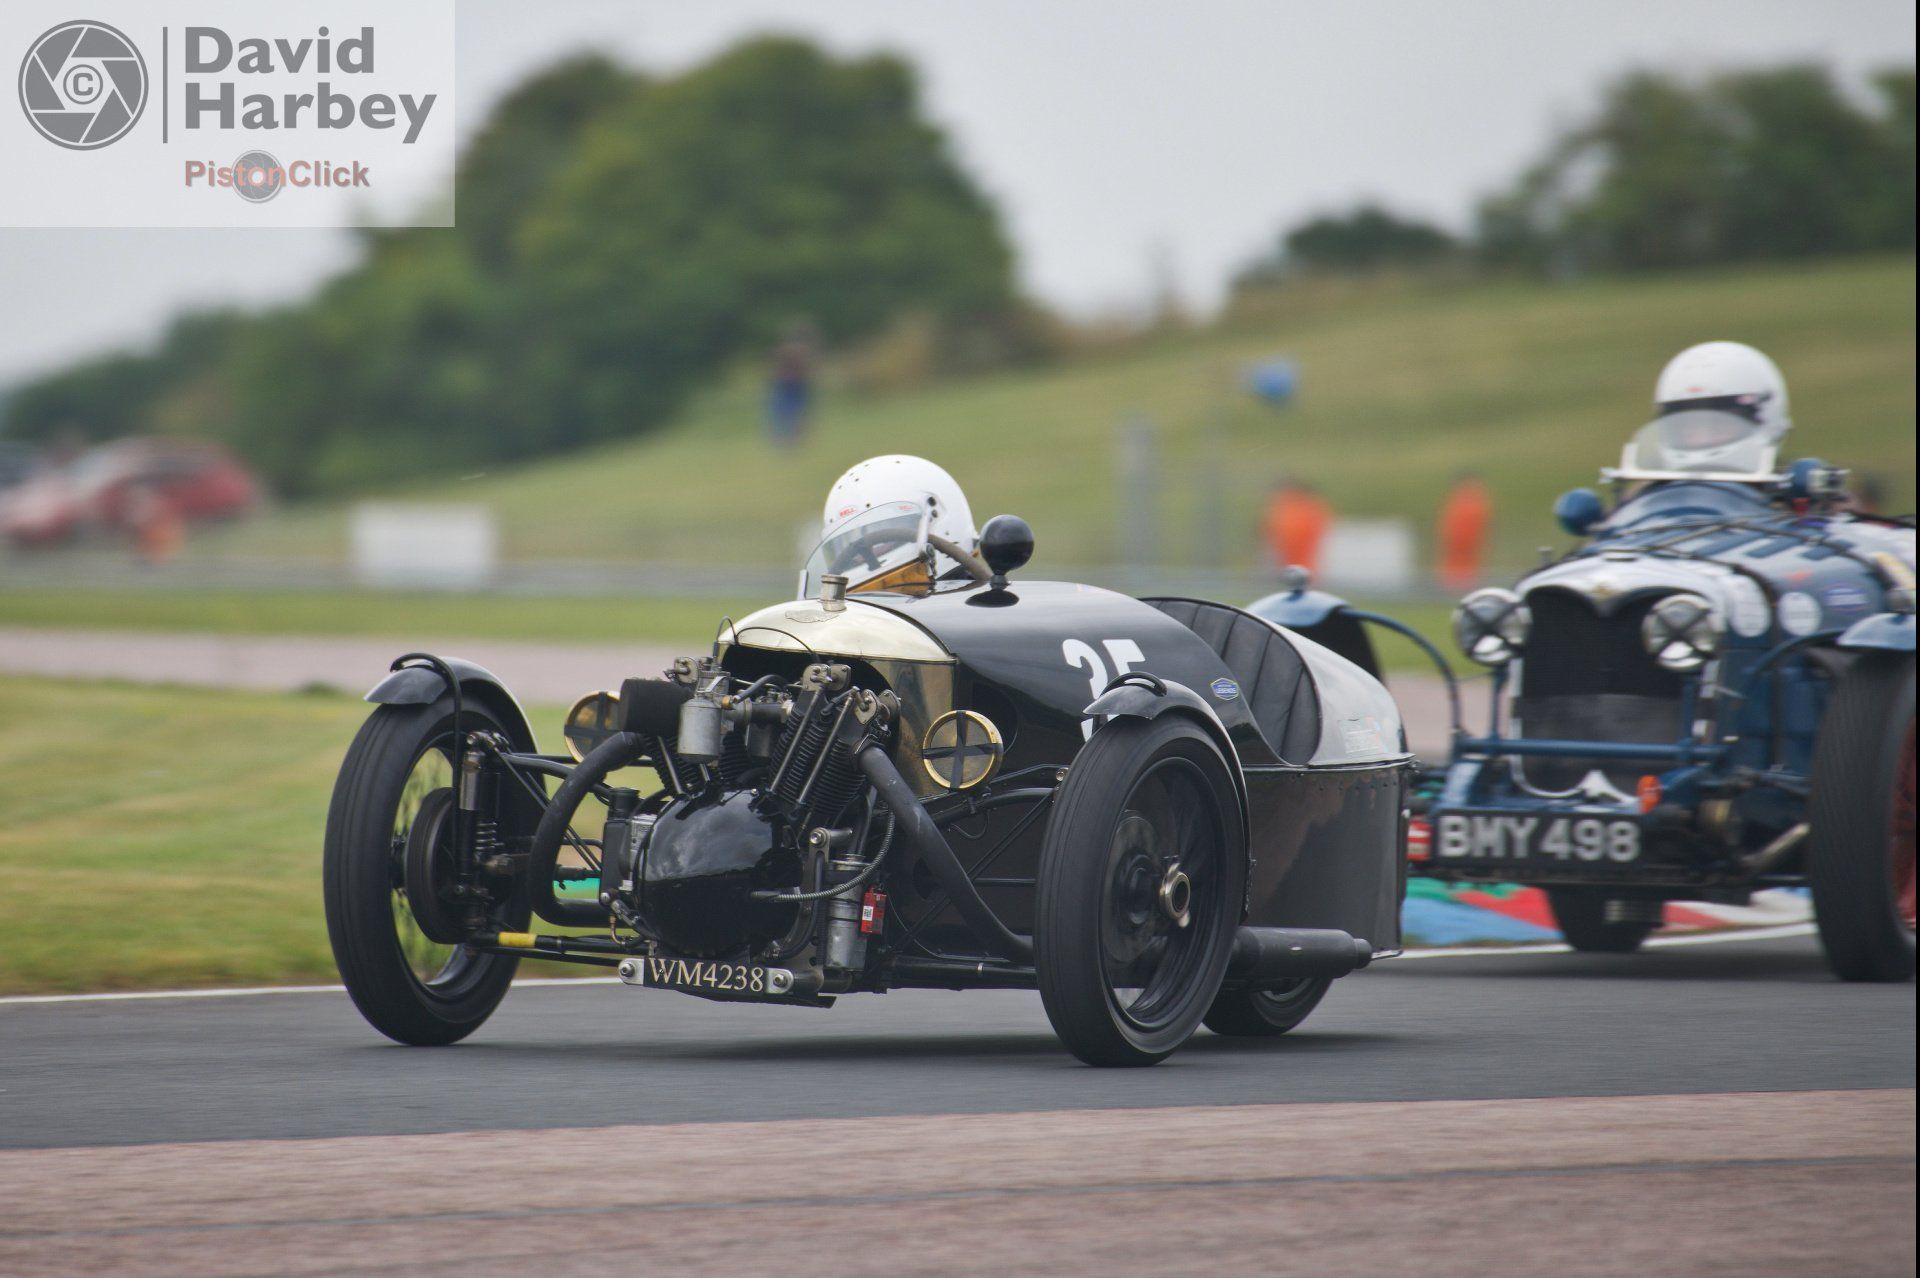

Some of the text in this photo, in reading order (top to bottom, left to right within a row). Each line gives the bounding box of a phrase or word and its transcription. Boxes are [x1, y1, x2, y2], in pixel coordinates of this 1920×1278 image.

[1437, 815, 1641, 862] BMY 498
[648, 957, 764, 992] WM4238
